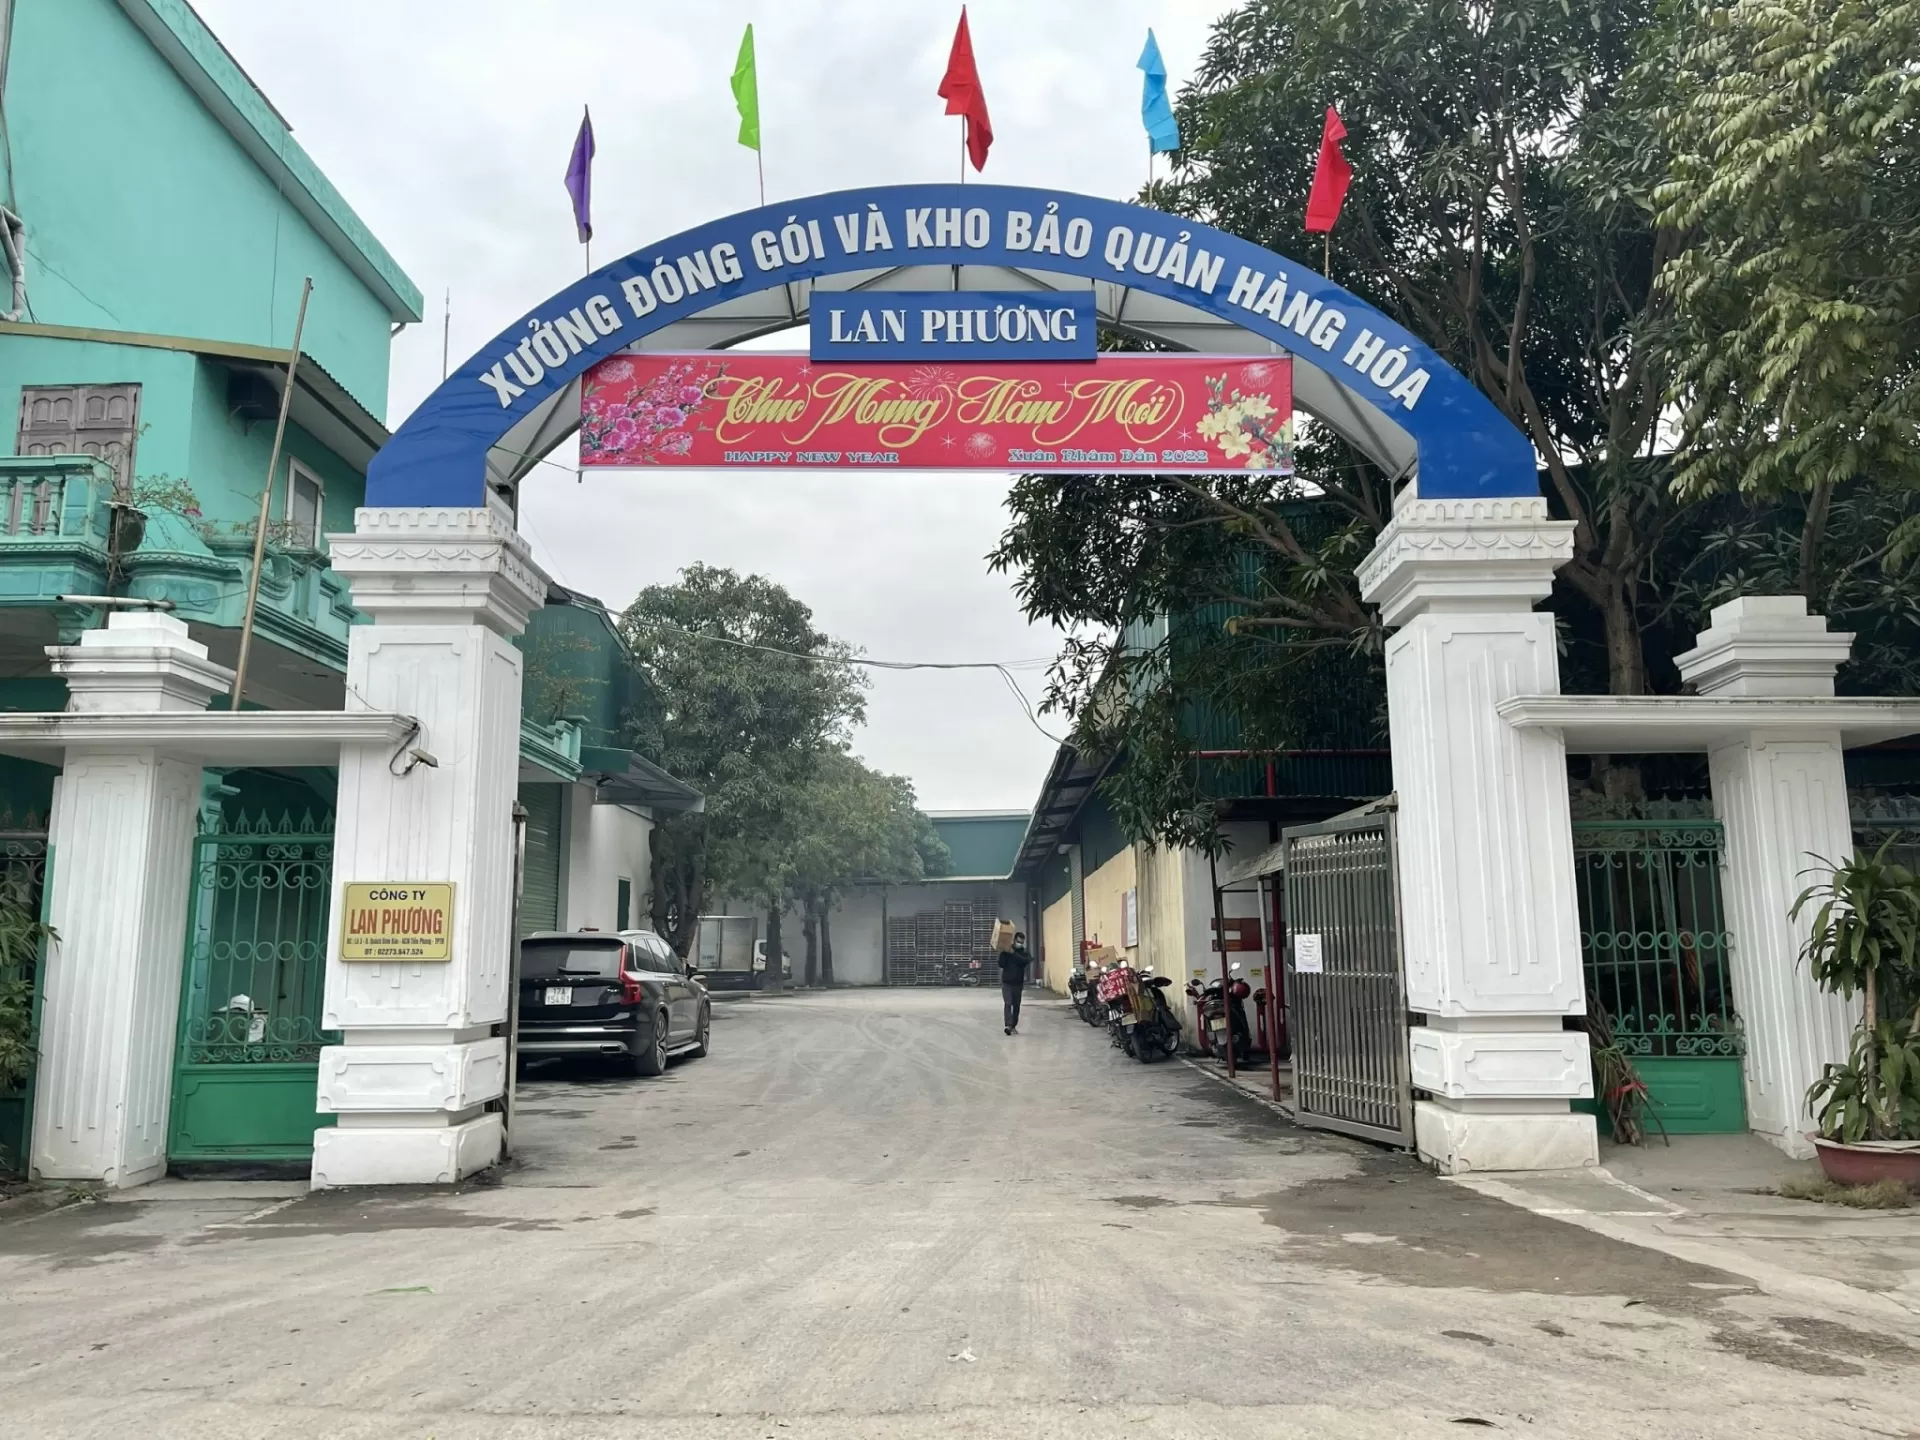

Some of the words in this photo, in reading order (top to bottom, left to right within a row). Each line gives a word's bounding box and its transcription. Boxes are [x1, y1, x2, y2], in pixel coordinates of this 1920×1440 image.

[478, 293, 624, 409] XƯỞNG
[620, 242, 744, 318] ĐÓNG
[750, 215, 826, 272] GÓI
[833, 203, 894, 254] VÀ
[905, 207, 991, 249] KHO
[1005, 201, 1093, 258] BẢO
[1104, 226, 1226, 294] QUẢN
[1227, 266, 1348, 352] HÀNG
[1342, 328, 1432, 412] HÓA
[828, 309, 906, 344] LAN
[920, 303, 1077, 344] PHƯƠNG
[702, 376, 812, 444] Chúc
[781, 373, 953, 448] Mừng
[1032, 378, 1185, 446] Mới
[724, 451, 792, 463] HAPPY
[796, 452, 842, 463] NEW
[845, 452, 900, 463] YEAR
[1008, 449, 1057, 462] Xuân
[1061, 449, 1116, 462] Nhâm
[1161, 449, 1208, 462] 2022
[369, 888, 408, 901] CÔNG
[412, 890, 426, 901] TY
[349, 908, 378, 935] LAN
[381, 906, 443, 935] PHƯƠNG
